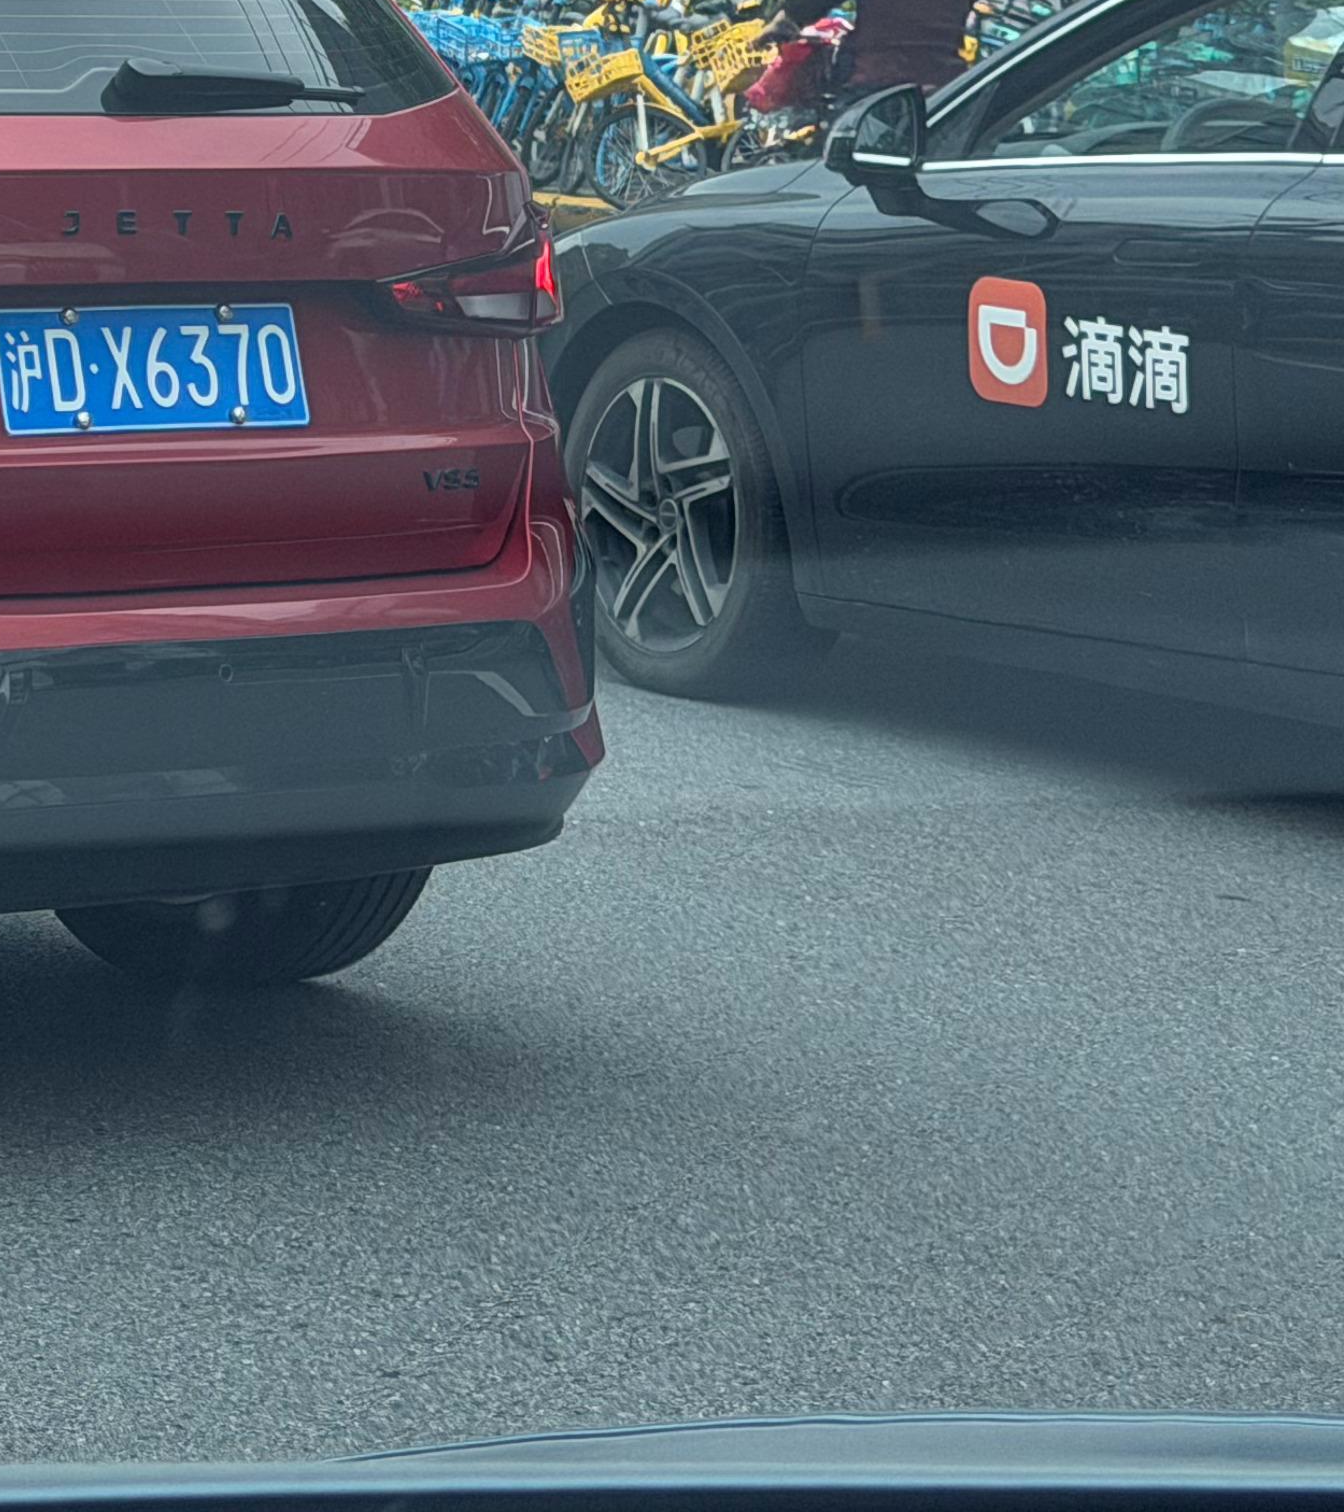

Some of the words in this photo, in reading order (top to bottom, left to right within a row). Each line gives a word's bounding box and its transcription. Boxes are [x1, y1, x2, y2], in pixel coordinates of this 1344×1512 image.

[62, 209, 294, 239] JETTA
[4, 323, 297, 413] 沪D·X6370
[1062, 315, 1190, 414] 滴滴
